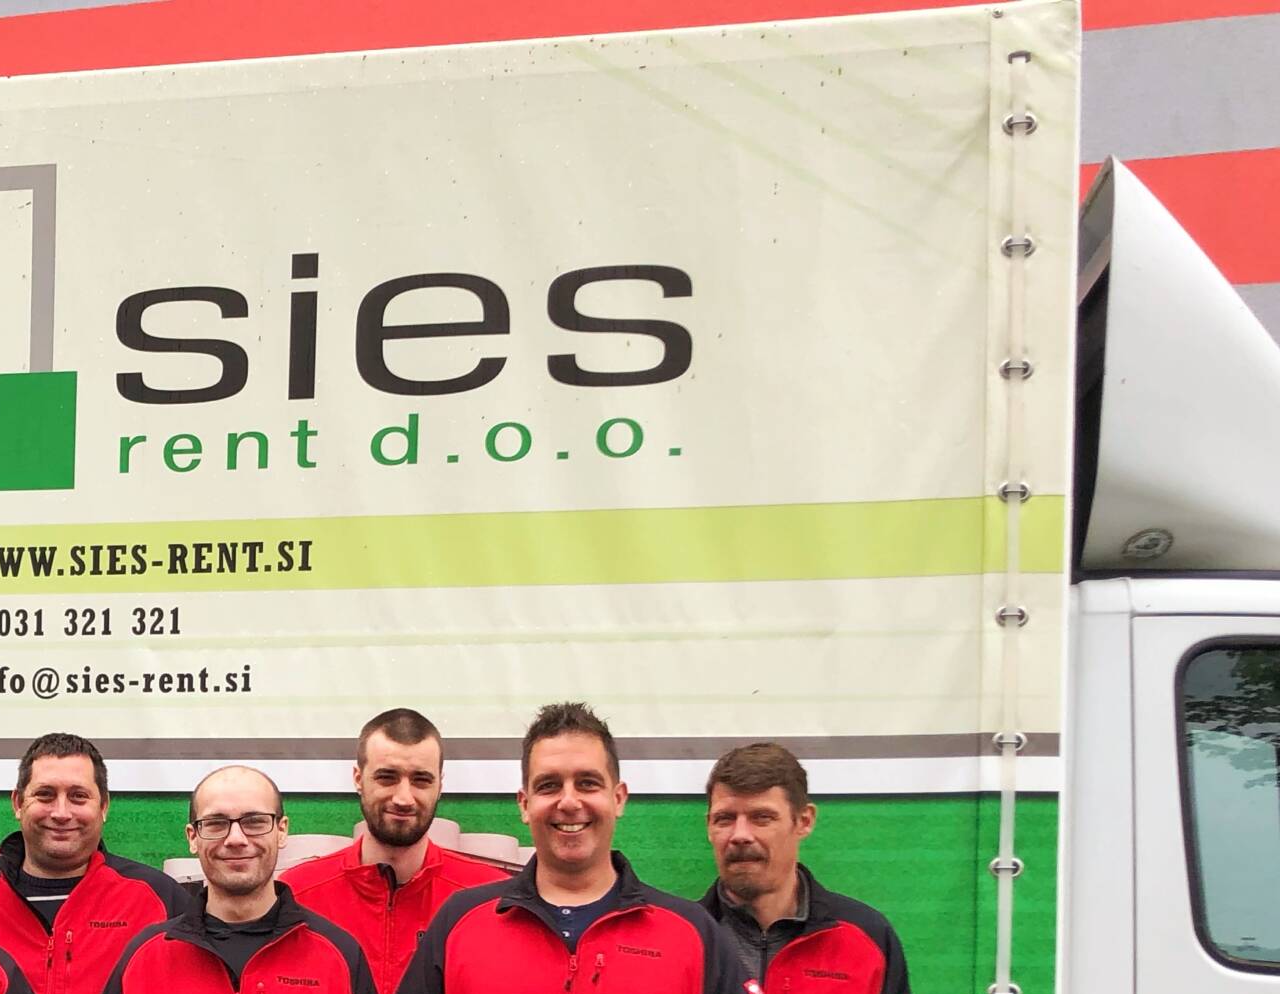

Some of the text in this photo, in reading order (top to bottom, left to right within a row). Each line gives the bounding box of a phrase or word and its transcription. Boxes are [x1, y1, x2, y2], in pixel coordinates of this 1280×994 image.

[116, 253, 693, 405] sies
[119, 413, 682, 473] rent d.o.o.
[63, 607, 112, 636] 321
[131, 607, 181, 636] 321
